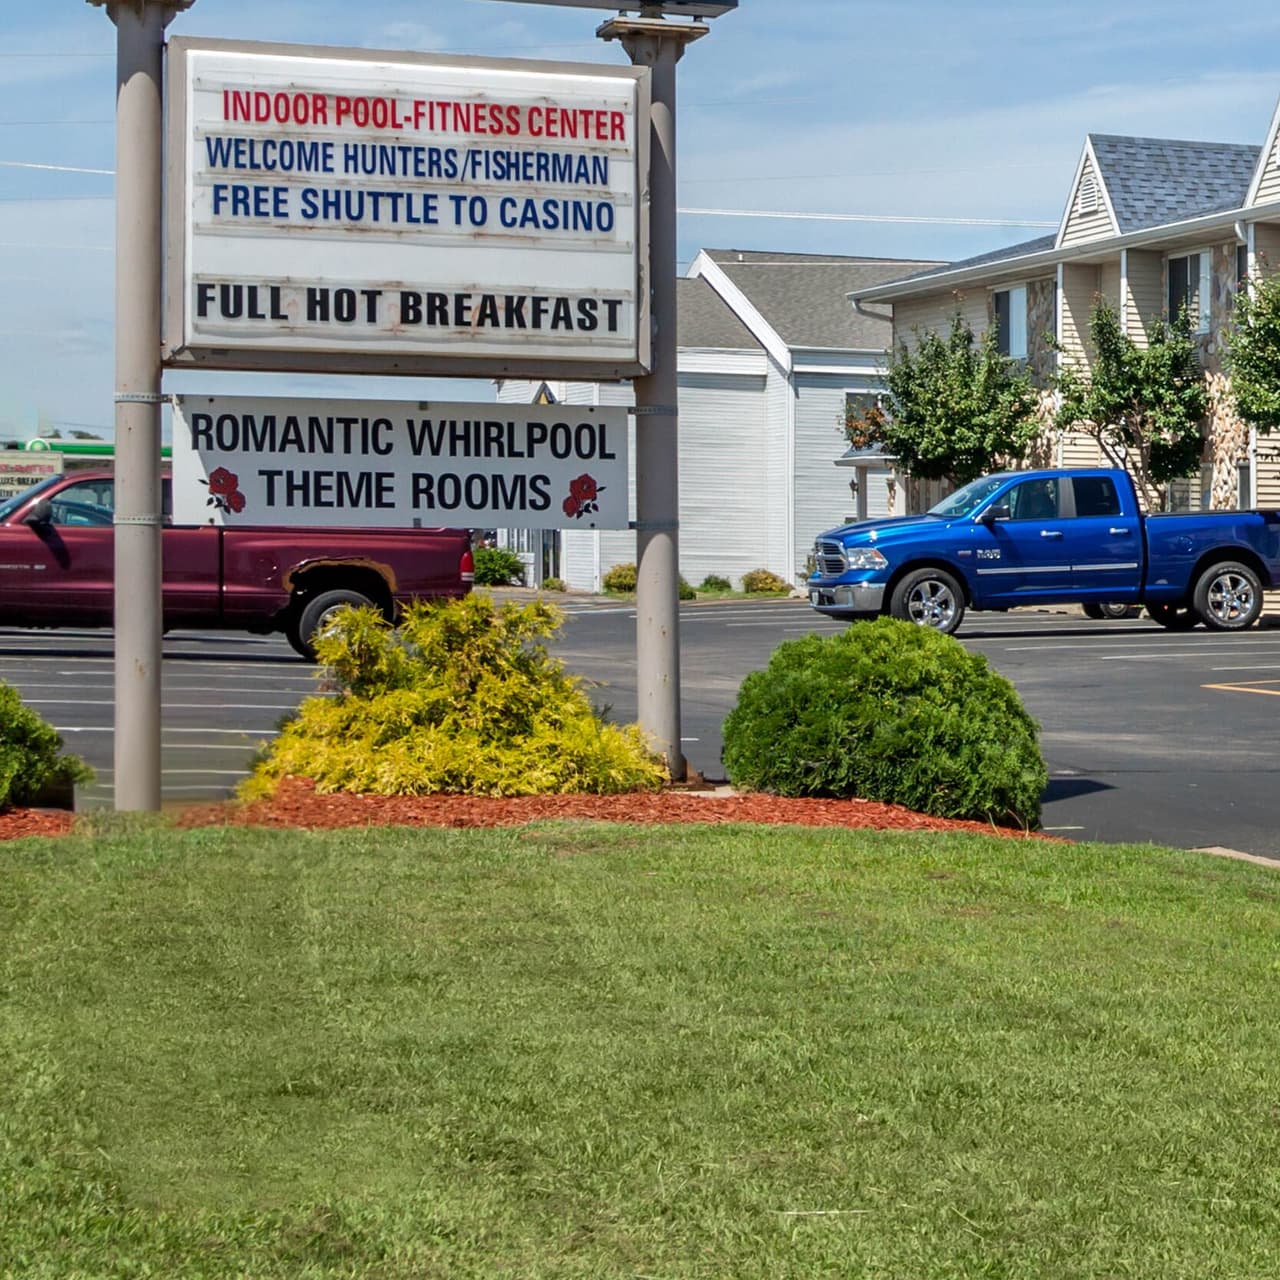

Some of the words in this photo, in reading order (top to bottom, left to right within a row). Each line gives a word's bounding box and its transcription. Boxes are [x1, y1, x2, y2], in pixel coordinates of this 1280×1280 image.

[222, 89, 328, 126] INDOOR
[335, 95, 520, 137] POOL-FITNESS
[527, 106, 626, 142] CENTER
[205, 136, 334, 174] WELCOME
[344, 143, 609, 186] HUNTERS/FISHERMAN
[212, 184, 289, 219] FREE
[301, 188, 439, 225] SHUTTLE
[449, 194, 488, 227] TO
[499, 197, 615, 233] CASINO
[197, 283, 289, 321] FULL
[307, 287, 382, 324] HOT
[400, 290, 622, 333] BREAKFAST
[191, 412, 394, 457] ROMANTIC
[407, 419, 616, 461] WHIRLPOOL
[258, 469, 396, 509] THEME
[411, 473, 552, 511] ROOMS
